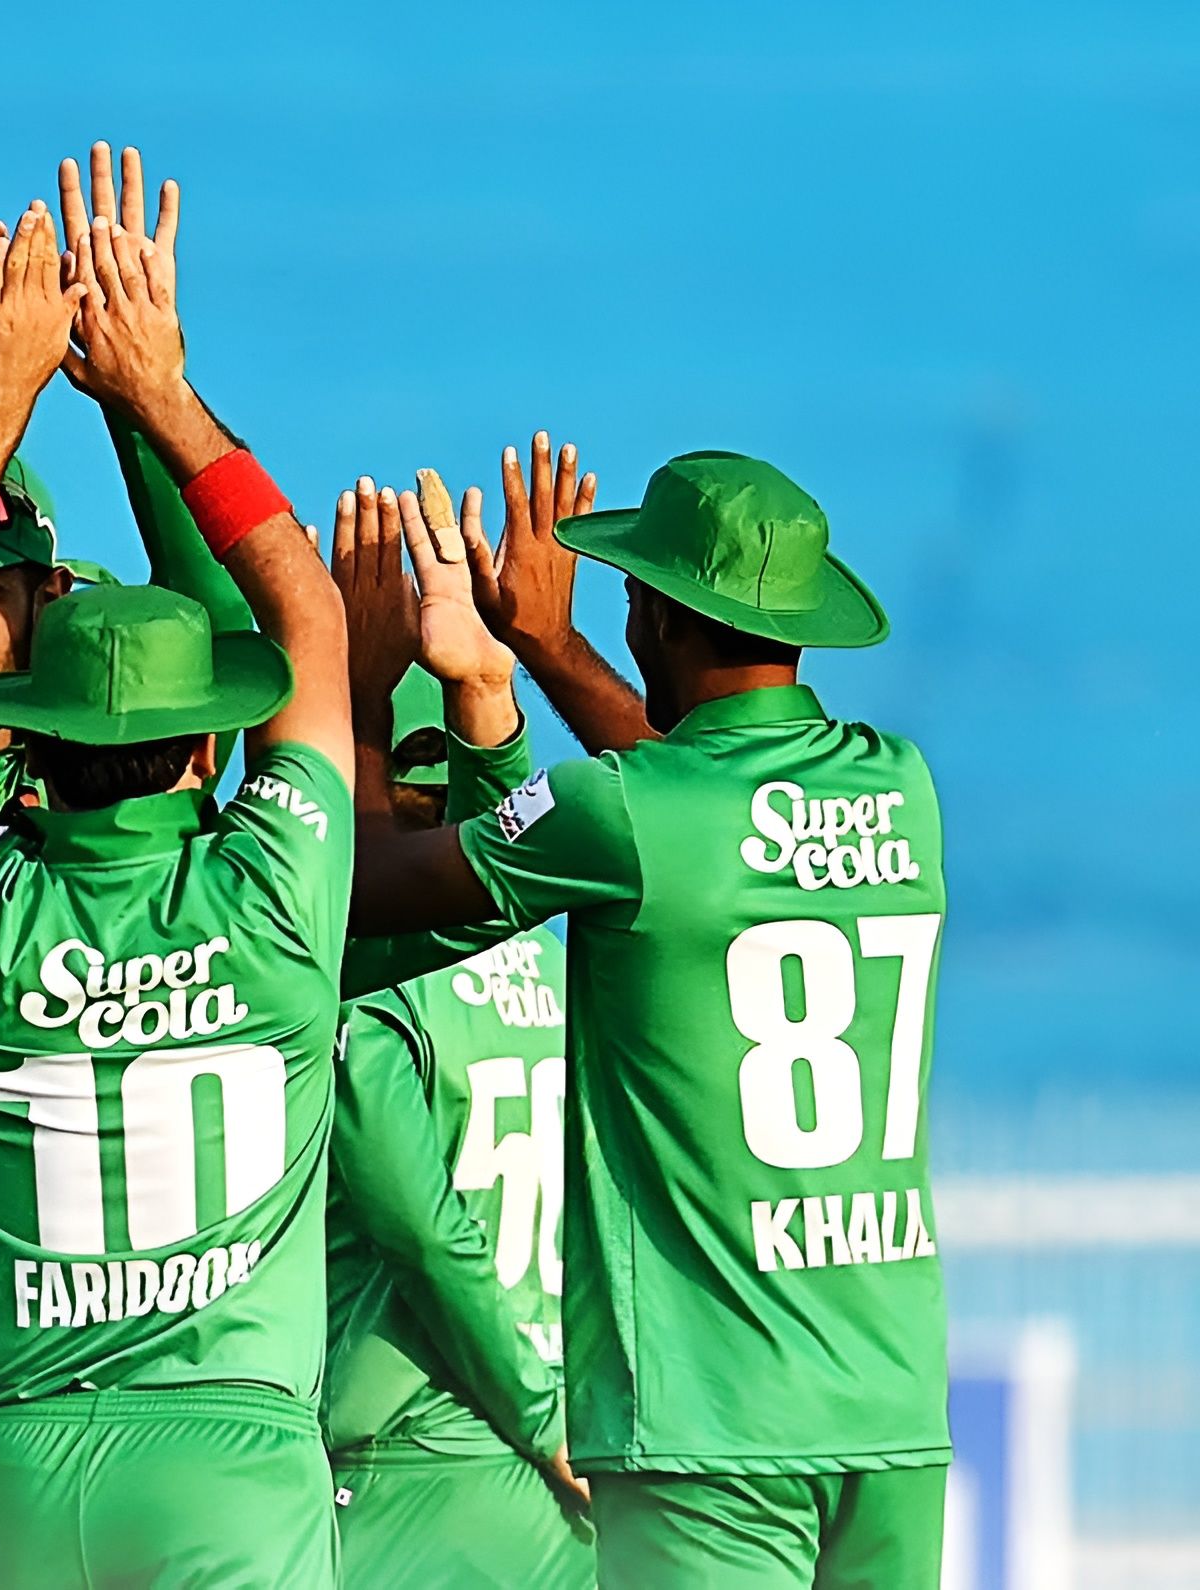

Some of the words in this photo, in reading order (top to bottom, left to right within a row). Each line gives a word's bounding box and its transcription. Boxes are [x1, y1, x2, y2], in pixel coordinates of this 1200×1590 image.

[740, 781, 905, 873] Super
[792, 836, 921, 891] cola
[20, 936, 230, 1028] Super
[78, 984, 249, 1049] cola
[725, 913, 941, 1169] 87
